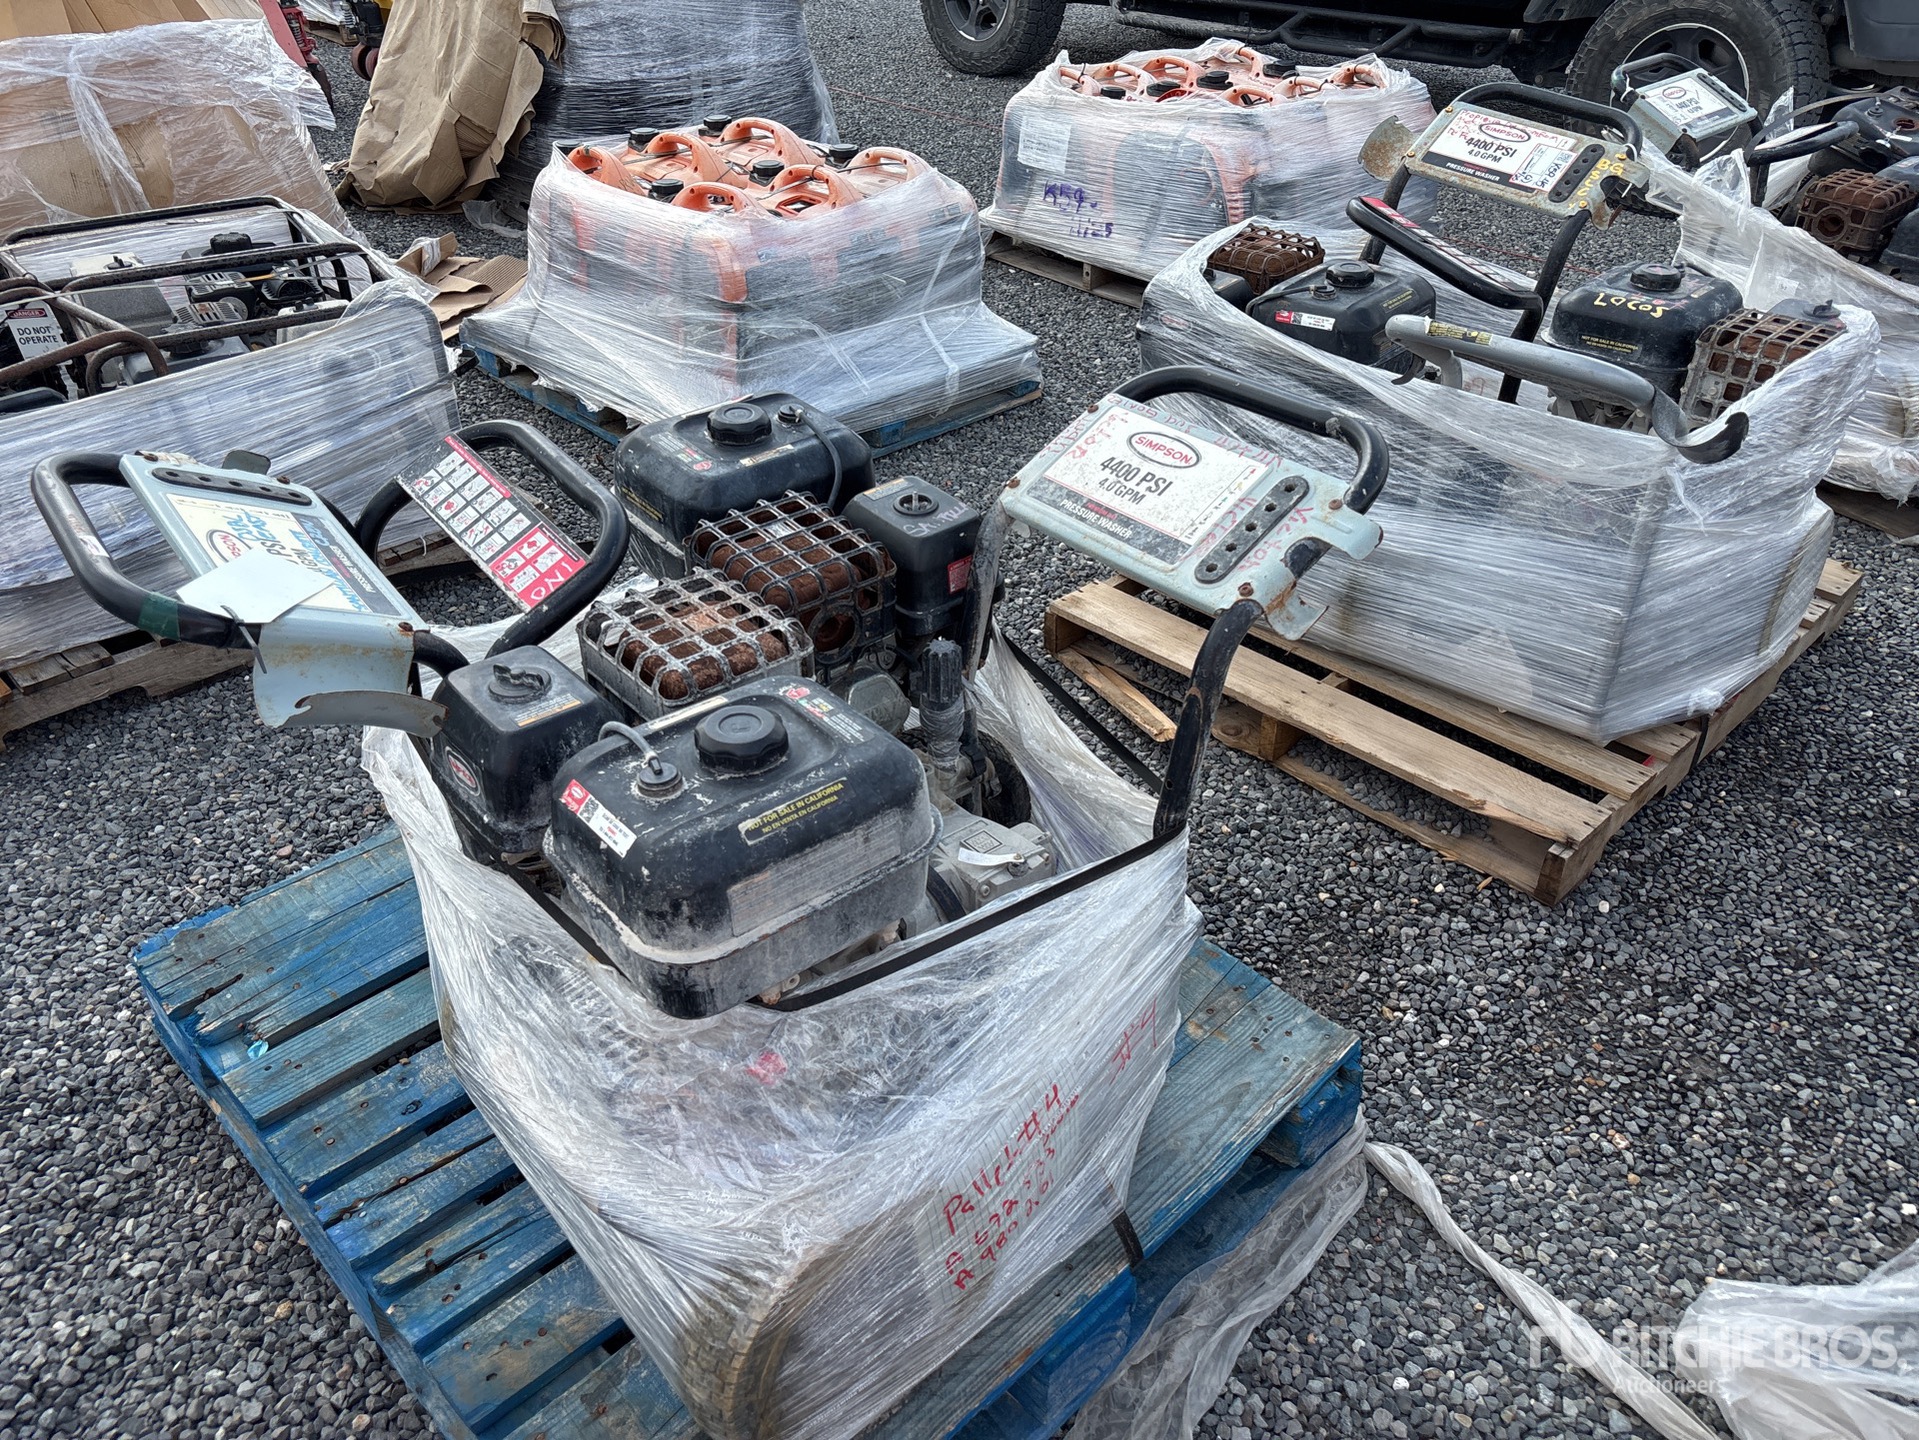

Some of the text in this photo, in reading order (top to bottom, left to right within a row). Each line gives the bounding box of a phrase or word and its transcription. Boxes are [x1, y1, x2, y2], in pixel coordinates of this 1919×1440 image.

[1484, 125, 1526, 140] SIMPSON
[1466, 136, 1517, 158] 4400 PSI
[1480, 153, 1502, 164] GPM
[1446, 162, 1475, 175] PRESSURE
[1474, 171, 1501, 182] WASHER
[17, 326, 52, 336] DO NOT
[19, 335, 58, 346] OPERATE
[1135, 435, 1193, 466] SIMPSON
[1100, 456, 1174, 497] 4400 PSI
[1113, 484, 1146, 506] GPM
[1060, 500, 1101, 524] PRESSURE
[1098, 517, 1133, 539] WASHER
[748, 782, 844, 831] NOT FOR SALE IN CALIFORNIA
[762, 795, 839, 834] NO EN VENTA EN CALIFORNIA
